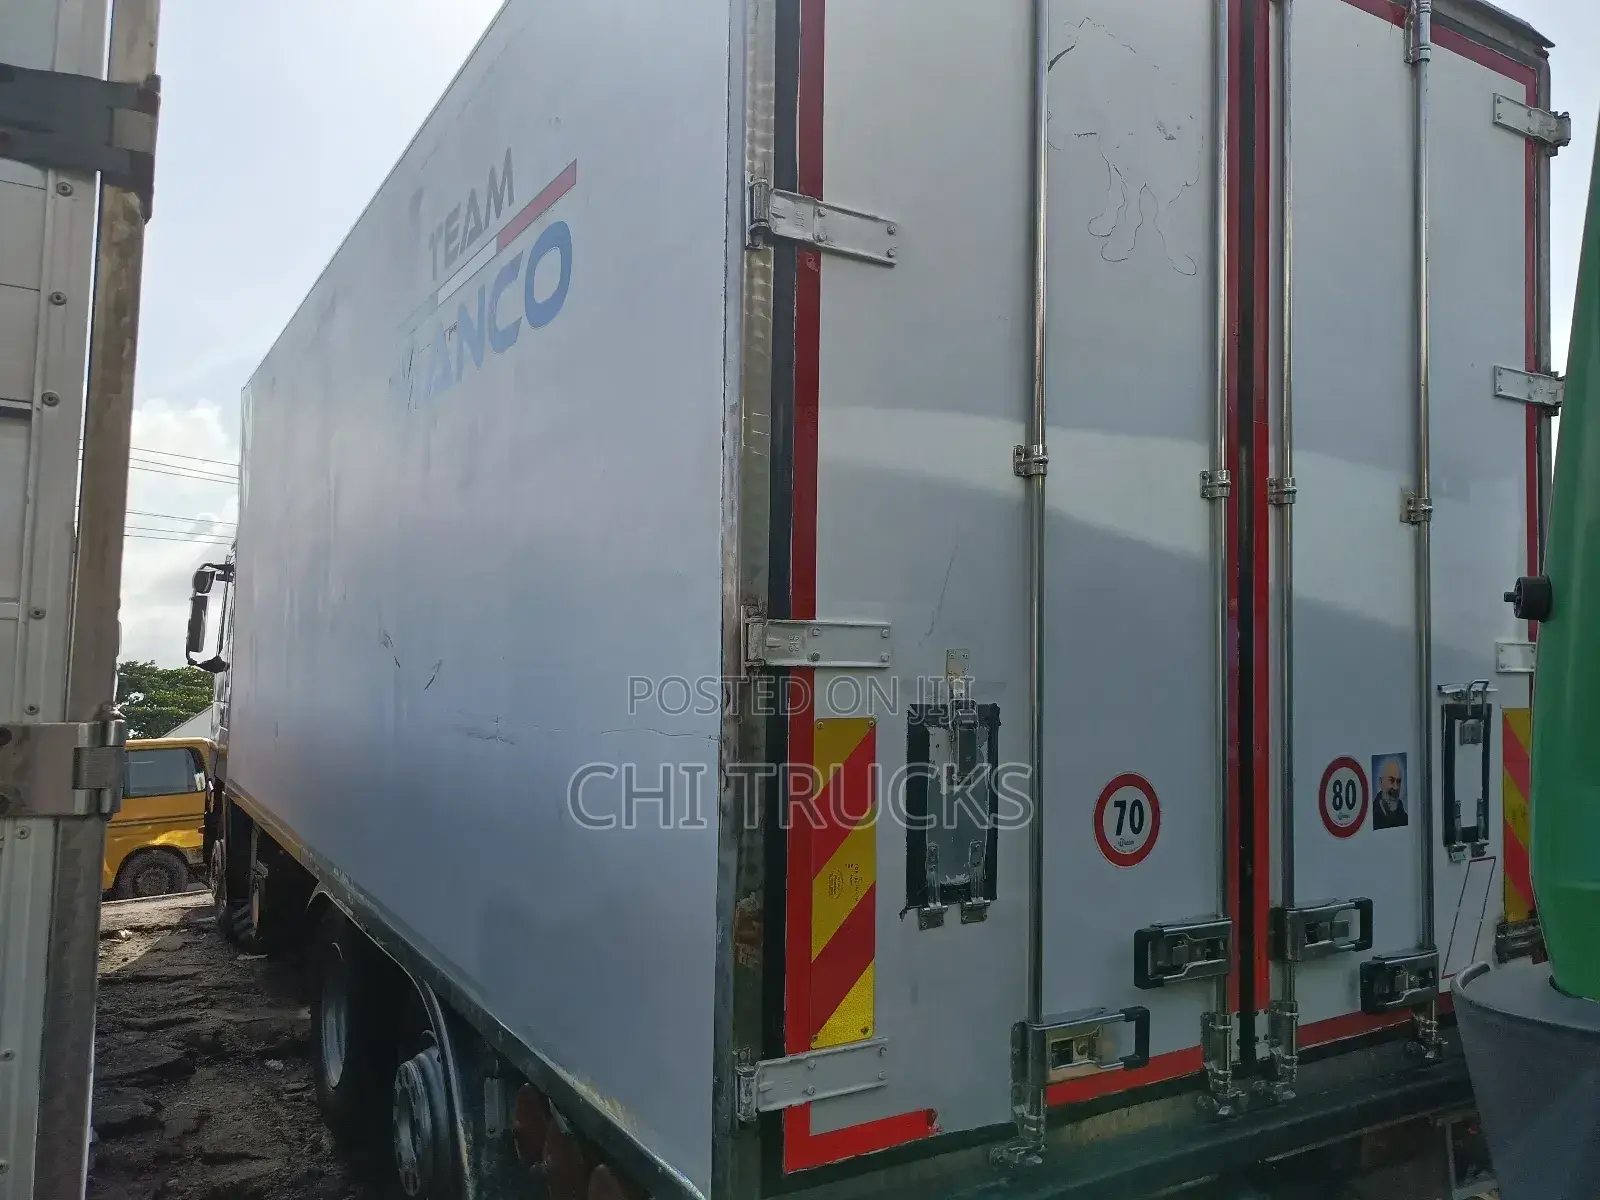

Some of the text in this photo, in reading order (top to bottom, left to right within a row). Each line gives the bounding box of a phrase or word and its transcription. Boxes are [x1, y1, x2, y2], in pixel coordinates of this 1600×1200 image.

[428, 146, 515, 281] TEAM
[1332, 779, 1357, 811] 80
[1113, 799, 1145, 836] 70
